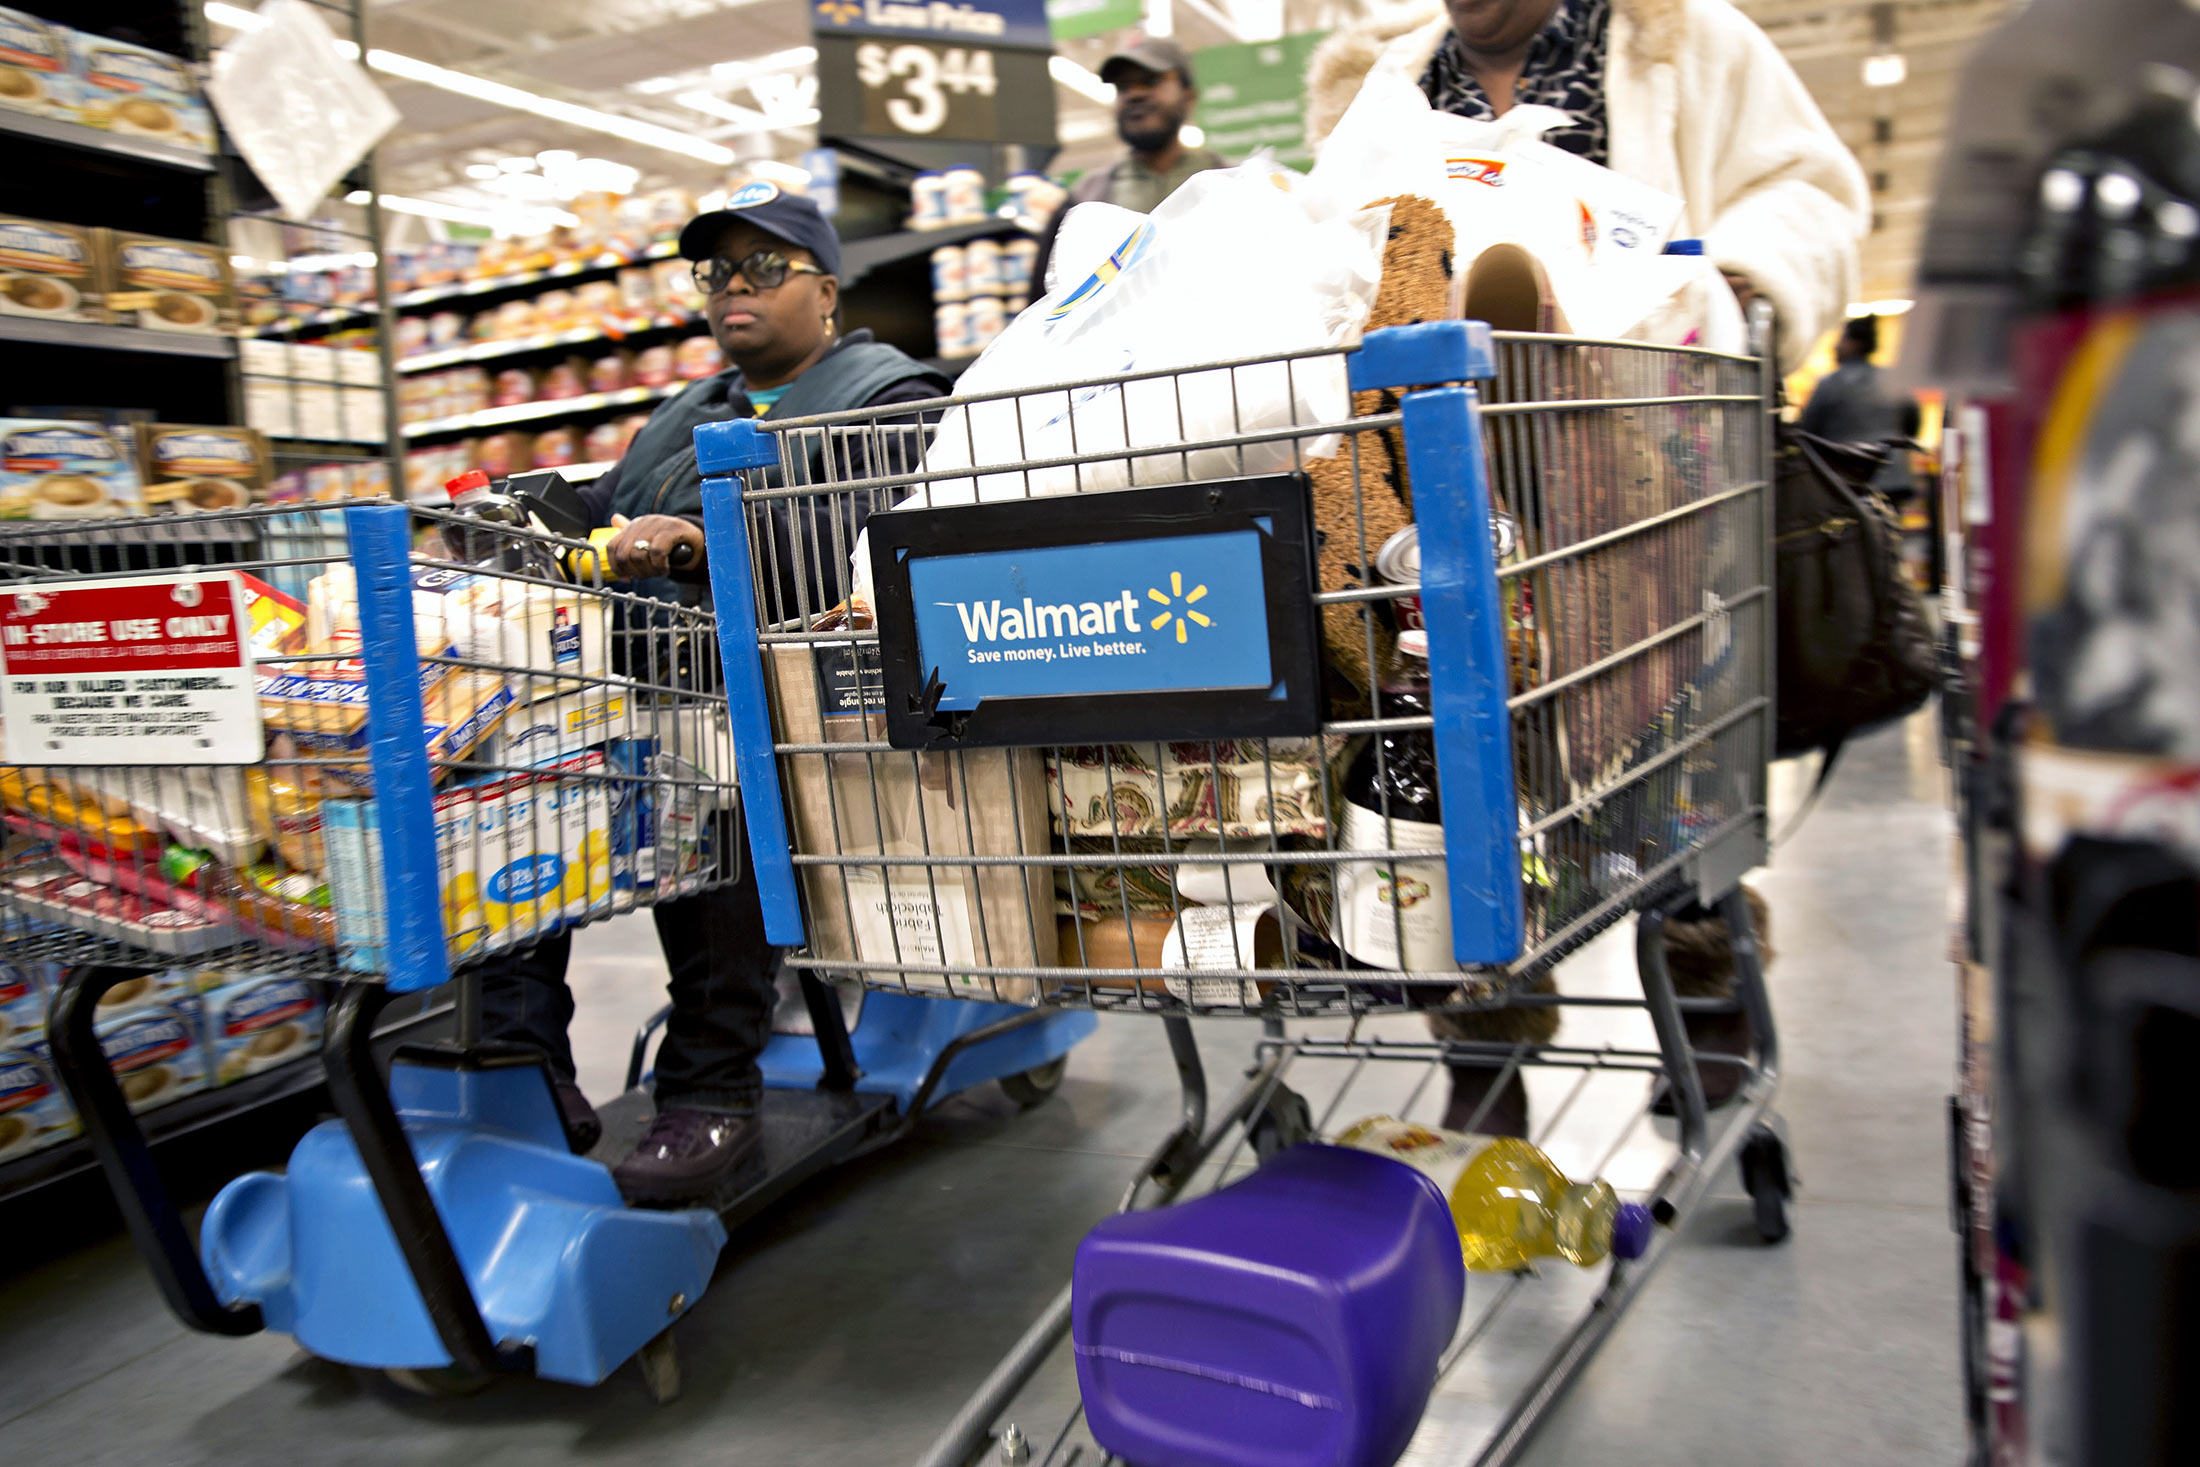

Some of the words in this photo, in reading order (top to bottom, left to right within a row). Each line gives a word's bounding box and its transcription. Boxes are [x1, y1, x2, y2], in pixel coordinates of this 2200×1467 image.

[3, 621, 108, 644] IN-STORE
[110, 618, 162, 641] USE
[165, 614, 230, 638] ONLY
[957, 590, 1141, 642] Walmart
[968, 649, 1001, 664] Save
[1004, 646, 1057, 663] money.
[1059, 643, 1091, 658] Live
[1093, 640, 1147, 656] better.
[497, 872, 508, 893] 6
